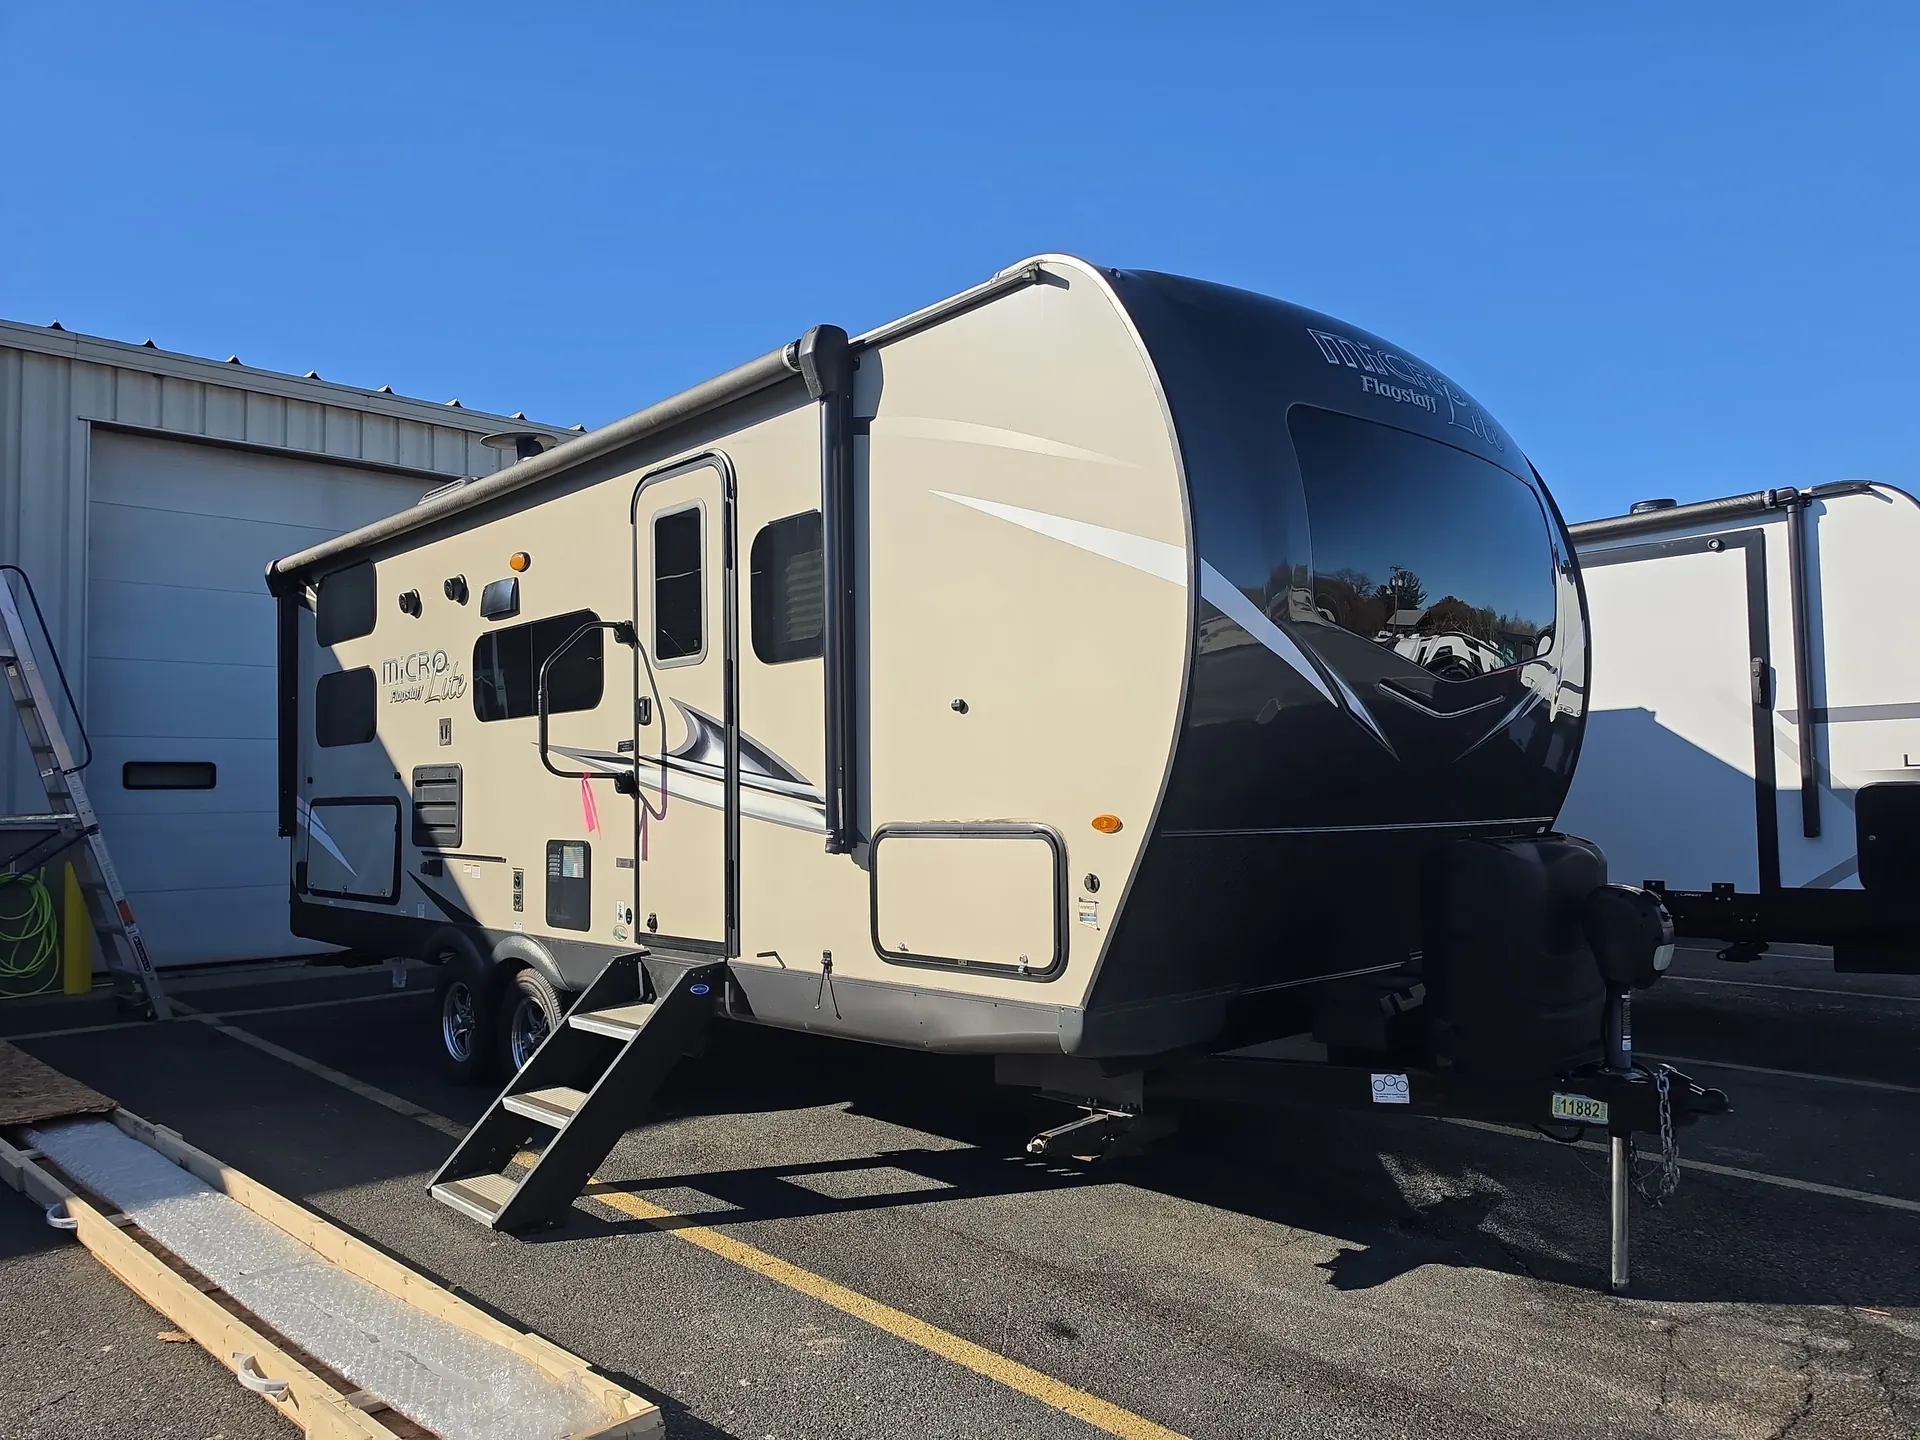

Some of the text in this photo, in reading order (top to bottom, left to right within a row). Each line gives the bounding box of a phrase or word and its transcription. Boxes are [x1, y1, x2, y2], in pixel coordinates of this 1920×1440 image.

[1360, 375, 1437, 414] Flagstaff
[1443, 384, 1503, 451] Lite
[424, 658, 467, 704] Lite
[1560, 1098, 1600, 1117] 11882
